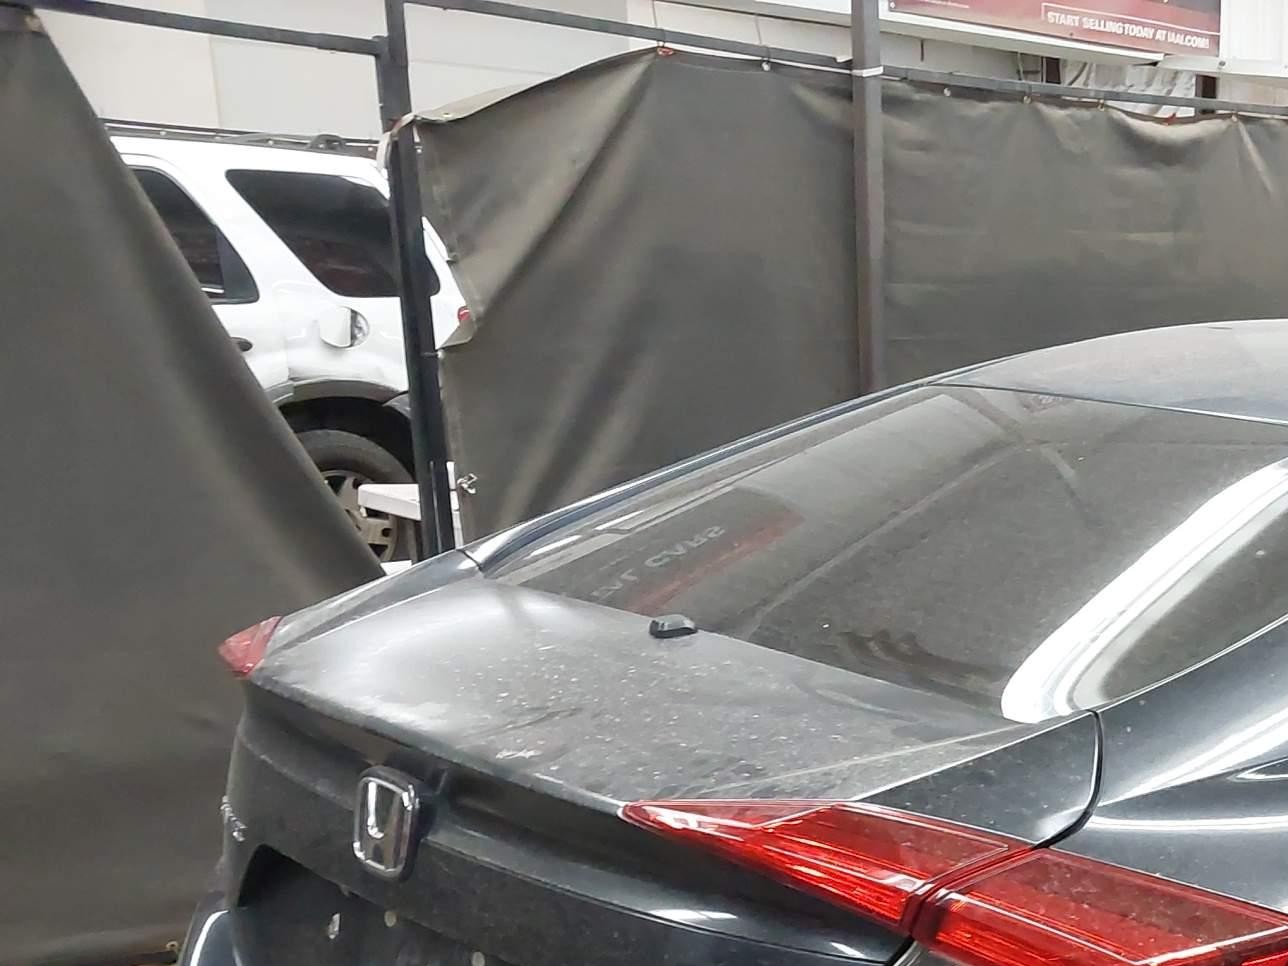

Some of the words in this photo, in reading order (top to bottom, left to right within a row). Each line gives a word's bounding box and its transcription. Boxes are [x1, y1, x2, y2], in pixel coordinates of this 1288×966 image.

[1047, 12, 1080, 26] START
[1082, 17, 1124, 35] SELLING
[1123, 24, 1154, 39] TODAY
[1156, 30, 1167, 42] AT
